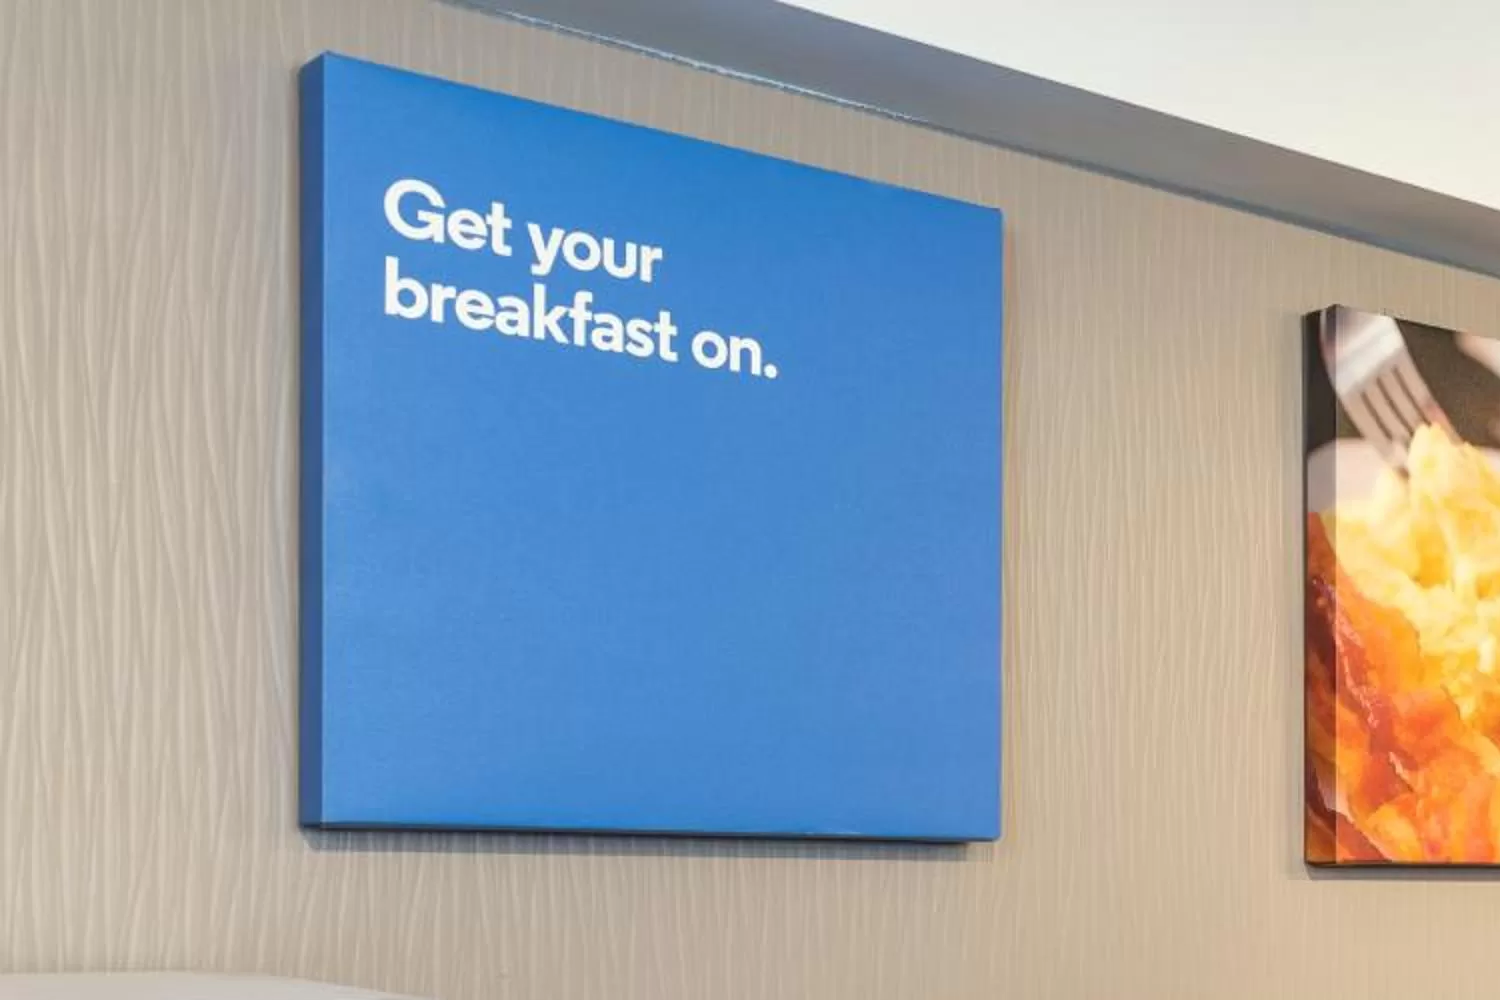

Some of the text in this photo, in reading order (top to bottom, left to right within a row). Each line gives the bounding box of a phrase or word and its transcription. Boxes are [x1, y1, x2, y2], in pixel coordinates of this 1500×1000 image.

[383, 178, 662, 283] Get your
[384, 256, 779, 379] breakfast on.
